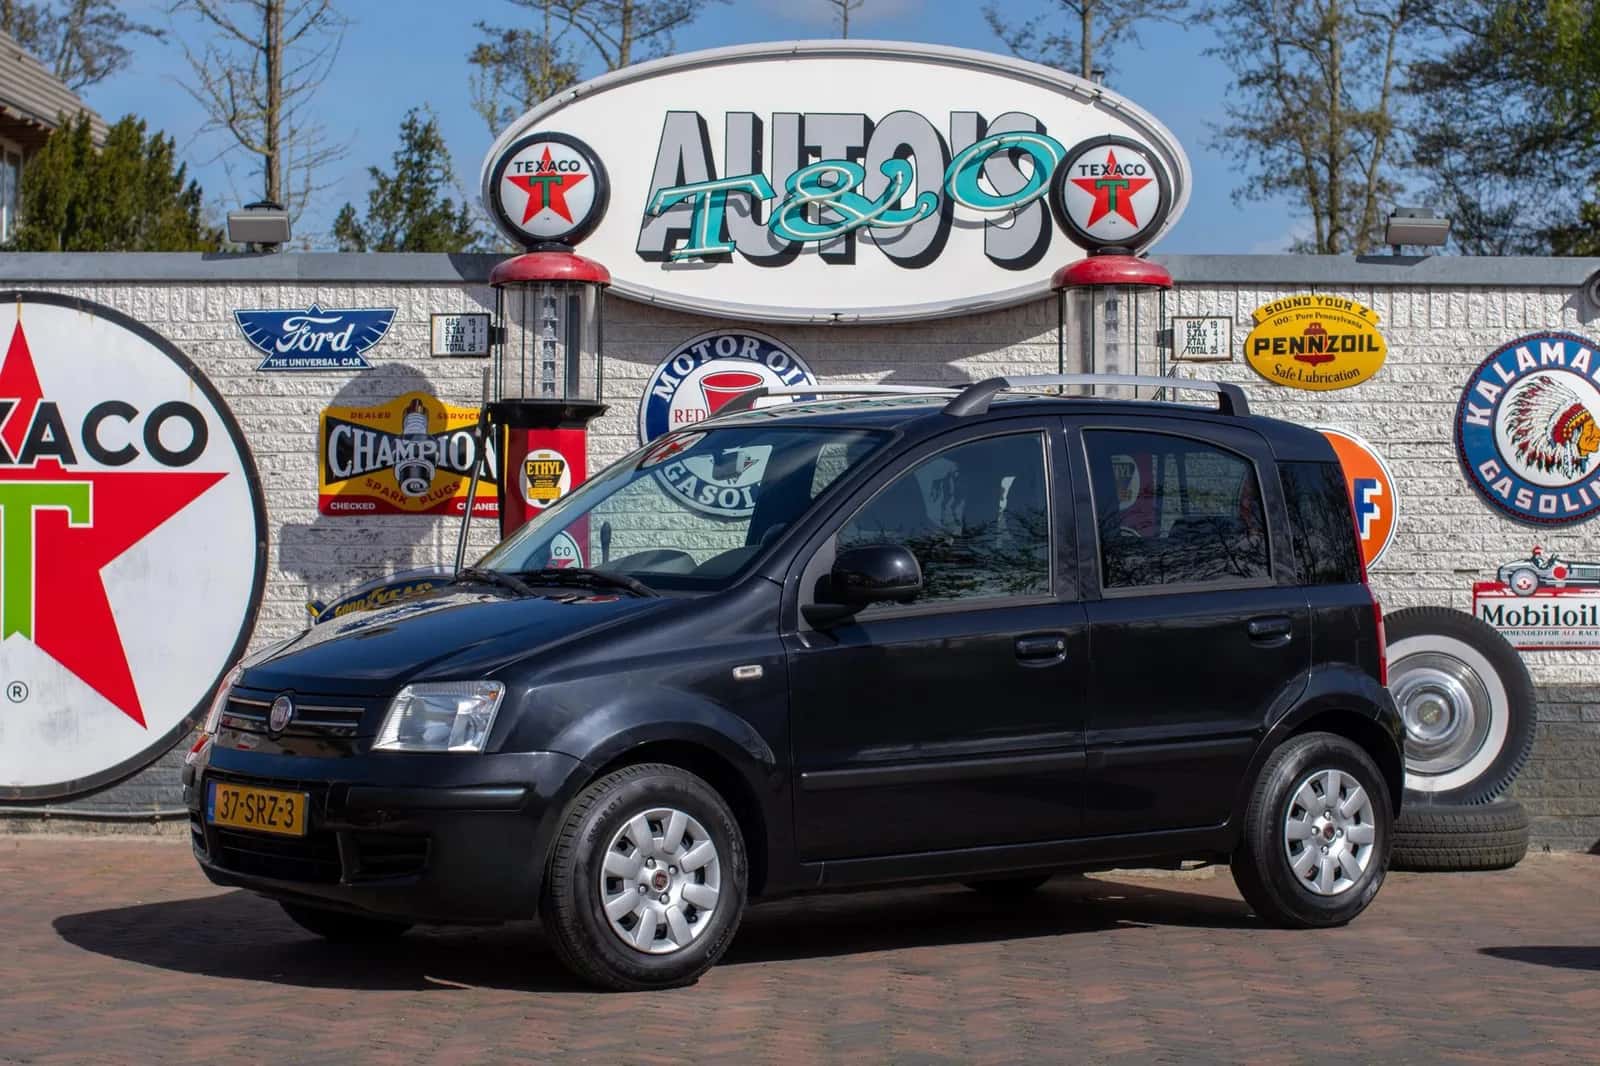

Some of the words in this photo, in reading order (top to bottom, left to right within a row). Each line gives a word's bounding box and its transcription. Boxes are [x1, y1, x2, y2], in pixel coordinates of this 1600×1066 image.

[514, 160, 581, 173] TEXACO
[1079, 164, 1146, 176] TEXACO
[636, 110, 1053, 271] AUTO'S
[1265, 297, 1311, 315] SOUND
[1313, 296, 1353, 311] YOUR
[445, 318, 460, 326] GAS
[1186, 320, 1201, 329] GAS
[276, 316, 356, 352] Ford
[445, 343, 466, 352] TOTAL
[1188, 346, 1208, 354] TOTAL
[1254, 335, 1379, 356] PENNZOIL
[289, 358, 339, 366] UNIVERSAL
[342, 358, 361, 366] CAR
[653, 336, 760, 403] MOTOR
[766, 350, 810, 386] OI
[1272, 363, 1296, 379] Safe
[1298, 367, 1360, 383] Lubrication
[350, 411, 392, 420] DEALER
[674, 409, 706, 423] RED
[328, 423, 497, 480] CHAMPION
[527, 461, 561, 475] ETHYL
[365, 478, 408, 504] SPARK
[419, 481, 461, 504] PLUGS
[664, 459, 759, 508] GASOL
[330, 502, 376, 510] CHECKED
[1354, 478, 1382, 540] F
[1481, 604, 1598, 626] Mobiloil
[220, 789, 295, 828] 37-SRZ-3
